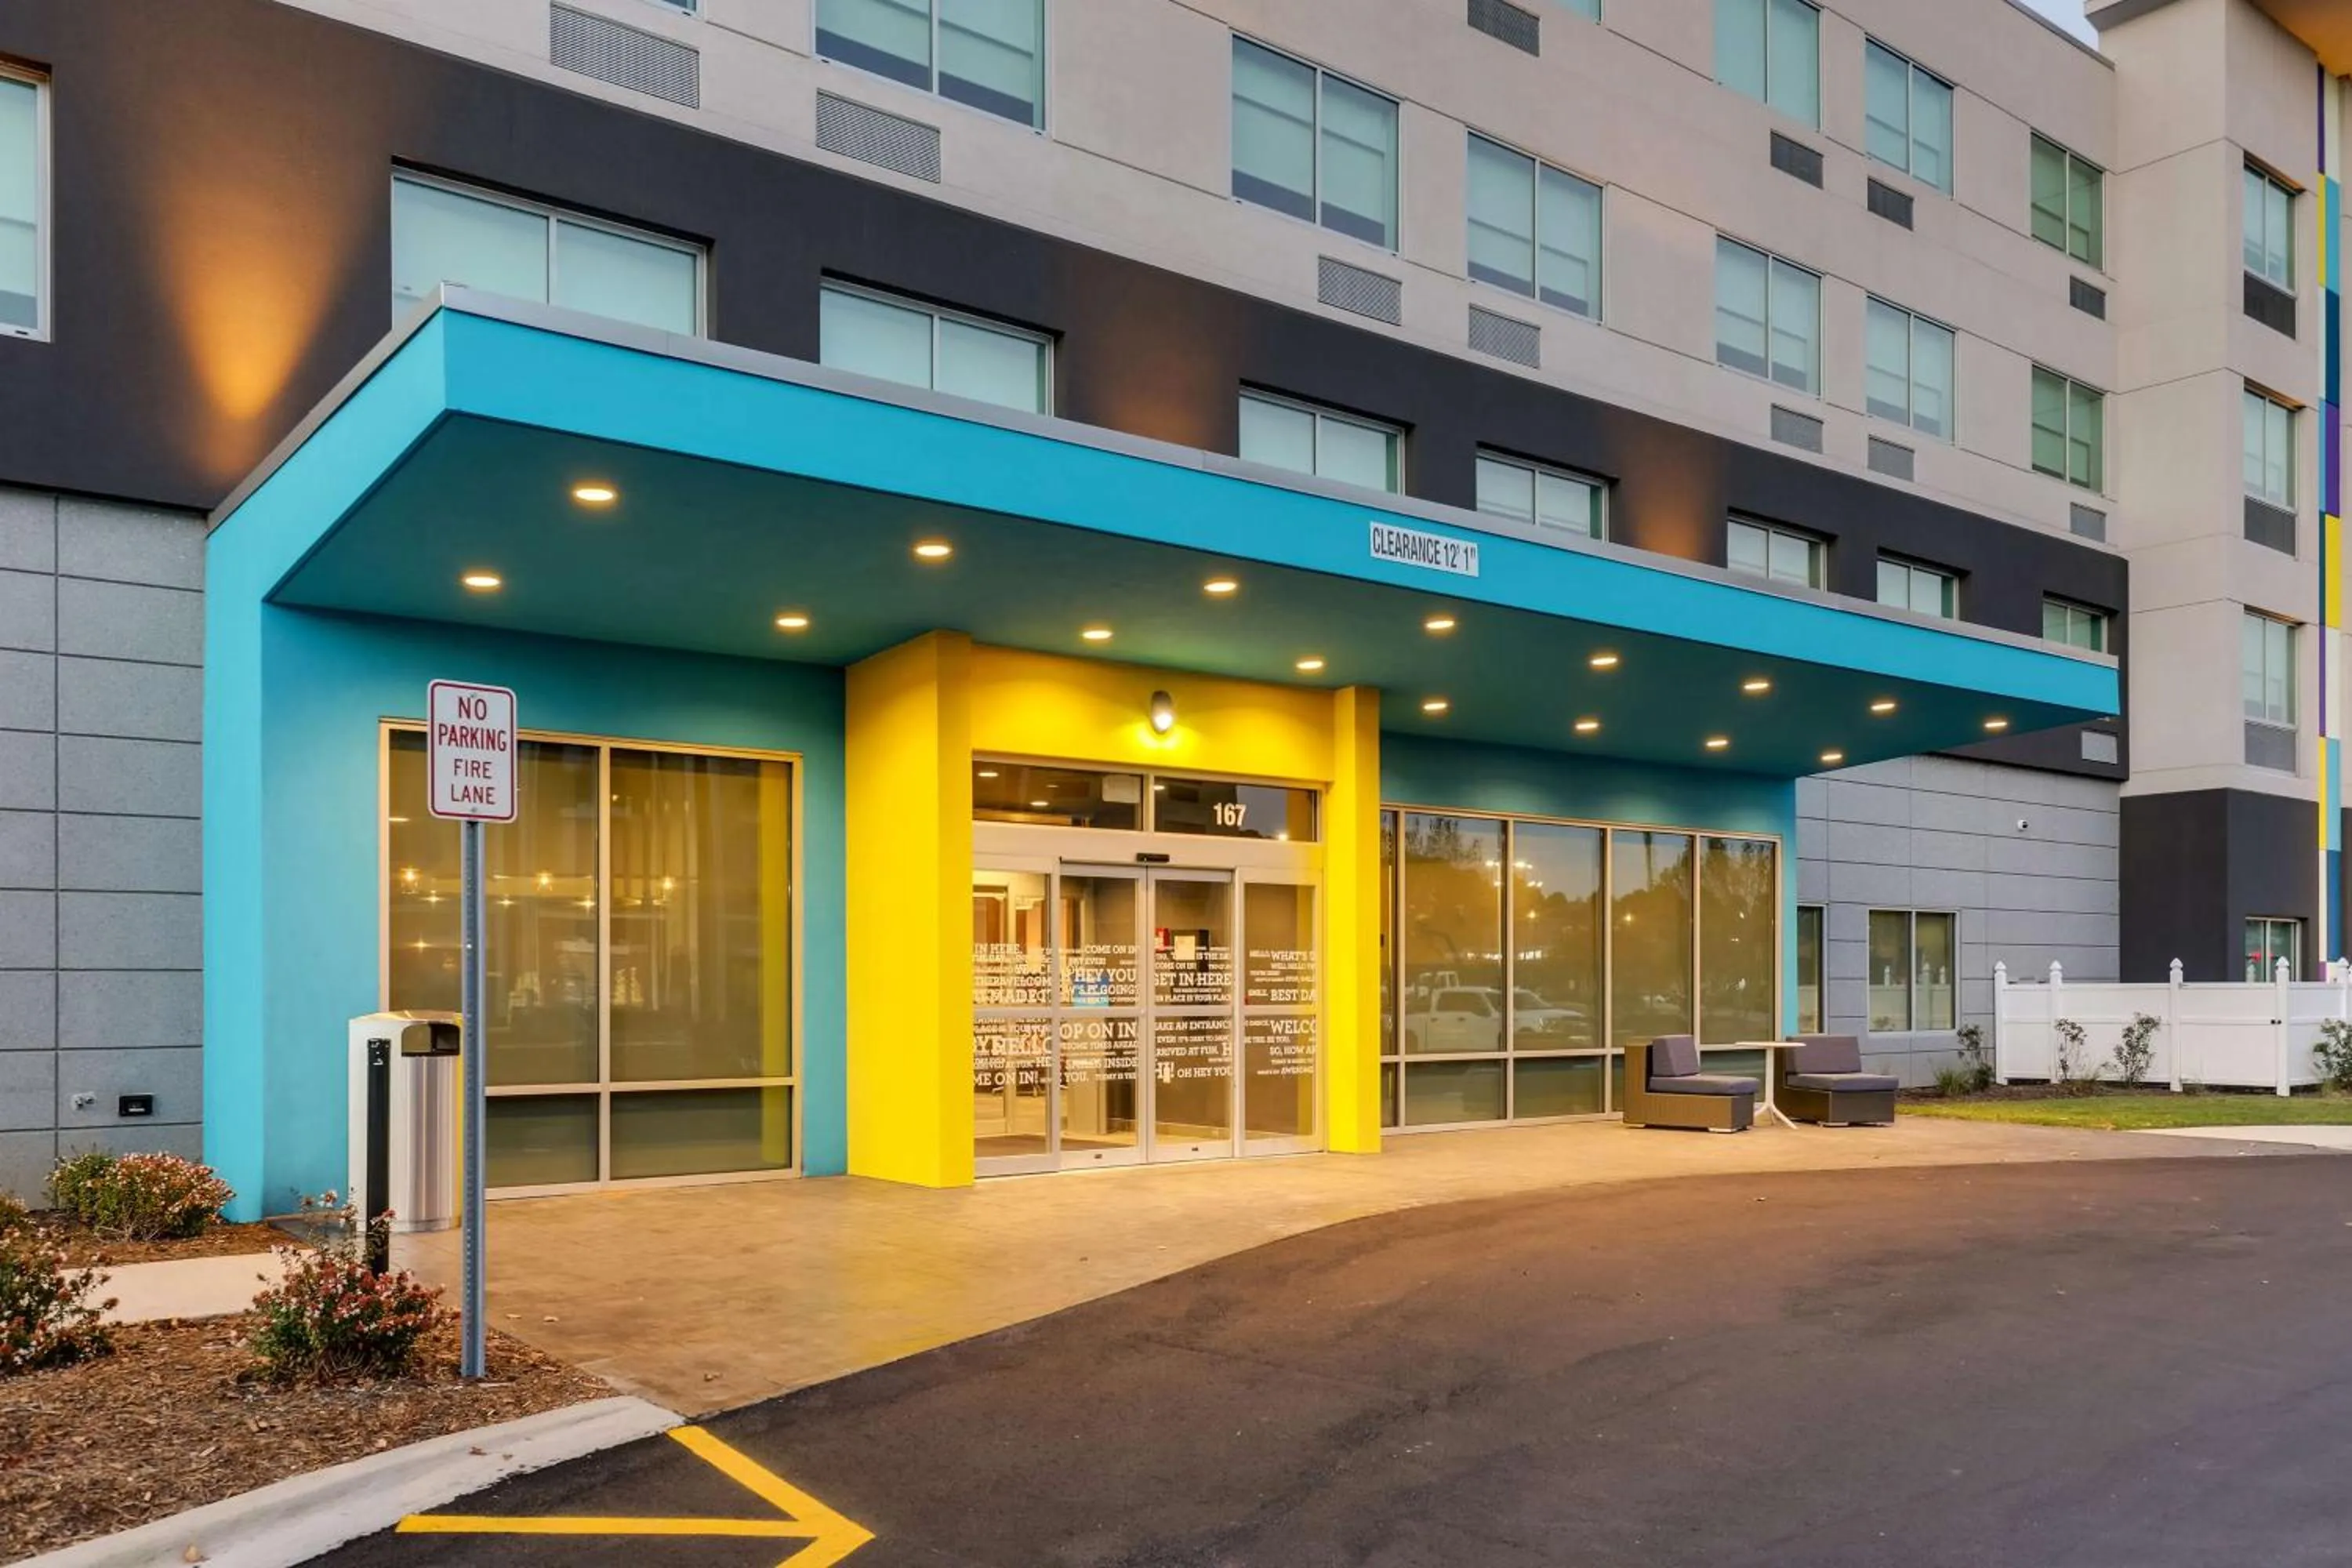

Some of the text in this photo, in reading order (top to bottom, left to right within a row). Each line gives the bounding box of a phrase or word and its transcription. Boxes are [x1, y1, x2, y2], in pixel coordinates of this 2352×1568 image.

[1373, 527, 1440, 564] CLEARANCE
[1444, 543, 1459, 568] 12'
[458, 696, 487, 720] NO
[438, 724, 507, 752] PARKING
[454, 759, 492, 779] FIRE
[451, 783, 495, 804] LANE
[1214, 802, 1247, 826] 167
[1107, 968, 1136, 982] YOU
[1179, 973, 1194, 985] IN
[1197, 972, 1231, 985] HERE
[1271, 989, 1298, 1000] BEST
[1087, 1022, 1114, 1039] ON
[1118, 1022, 1137, 1038] IN
[995, 1072, 1015, 1085] ON
[1019, 1070, 1039, 1084] IN!
[1177, 1068, 1192, 1078] OH
[1193, 1067, 1212, 1077] HEY
